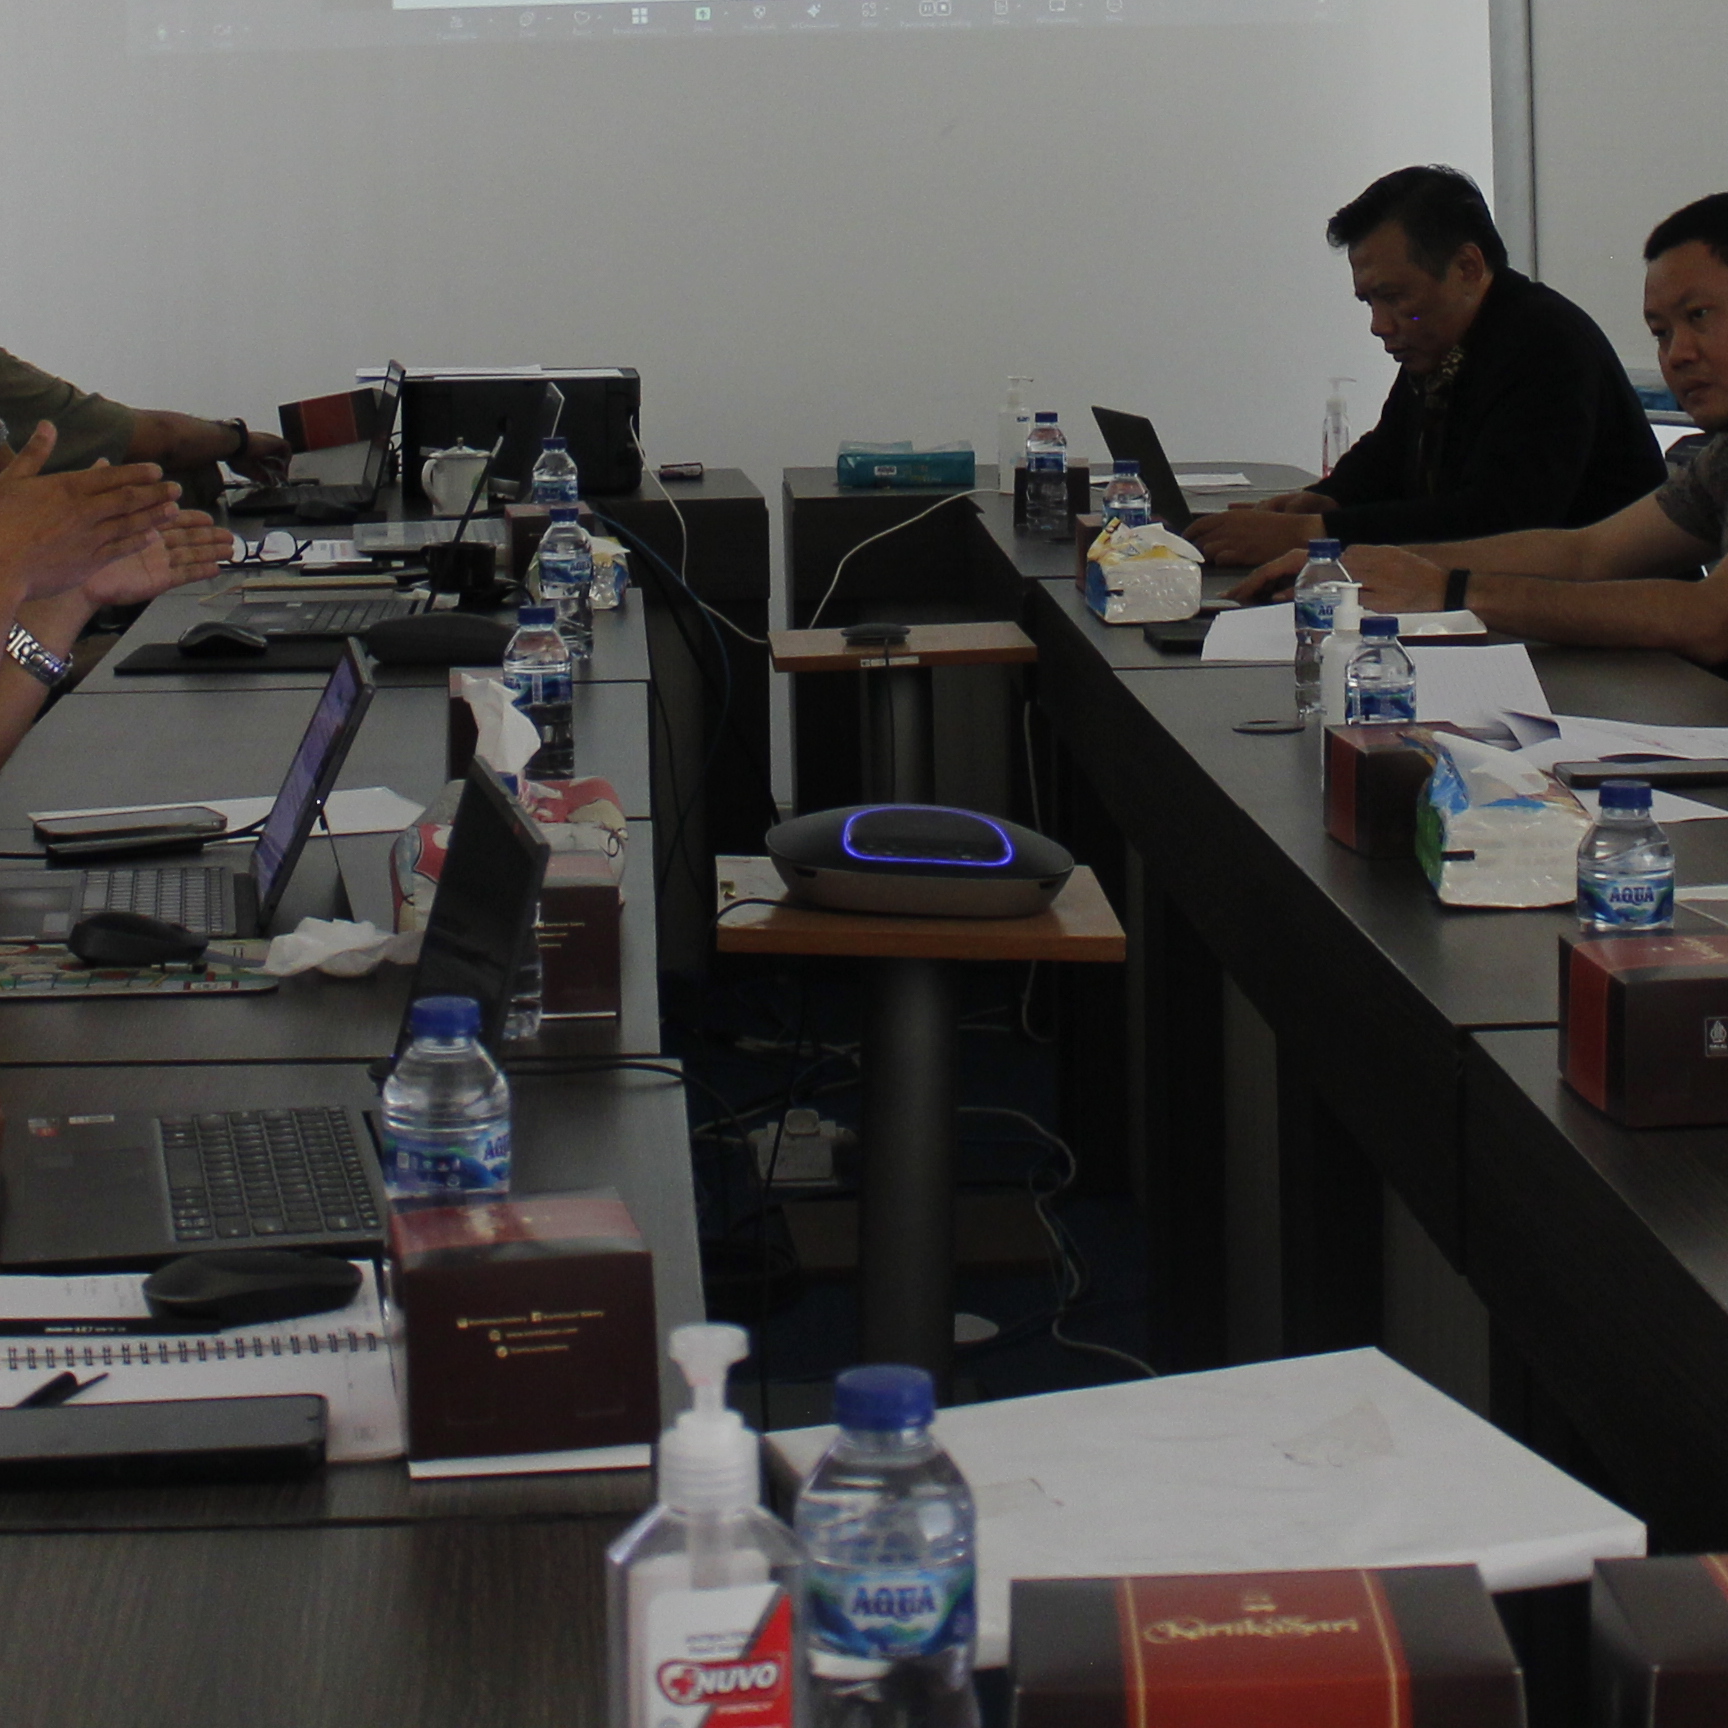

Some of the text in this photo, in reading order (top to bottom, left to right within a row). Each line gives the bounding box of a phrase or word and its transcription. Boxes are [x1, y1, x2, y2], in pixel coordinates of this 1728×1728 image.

[1609, 886, 1655, 905] AQUA
[852, 1586, 937, 1622] AQUA
[697, 1661, 779, 1695] NUVO
